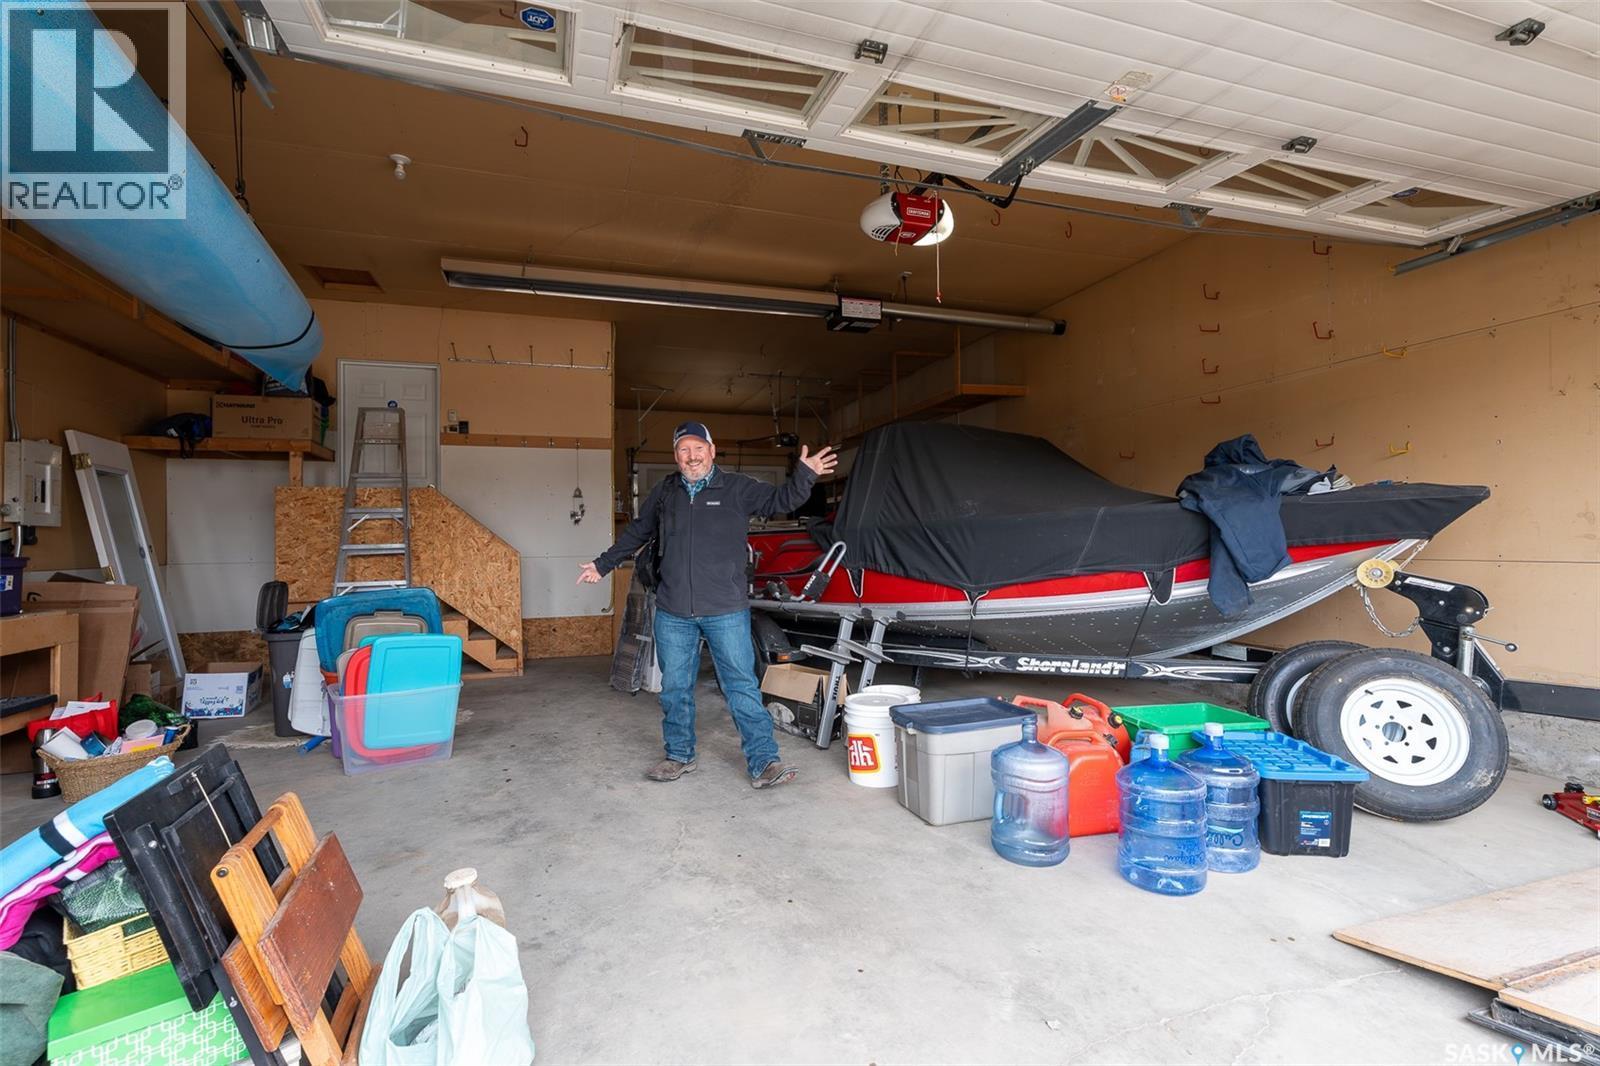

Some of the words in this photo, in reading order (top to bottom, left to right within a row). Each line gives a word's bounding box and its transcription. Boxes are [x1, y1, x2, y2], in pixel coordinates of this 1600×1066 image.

[241, 415, 264, 424] Ultra
[267, 416, 284, 425] Pro
[831, 675, 841, 701] THULE
